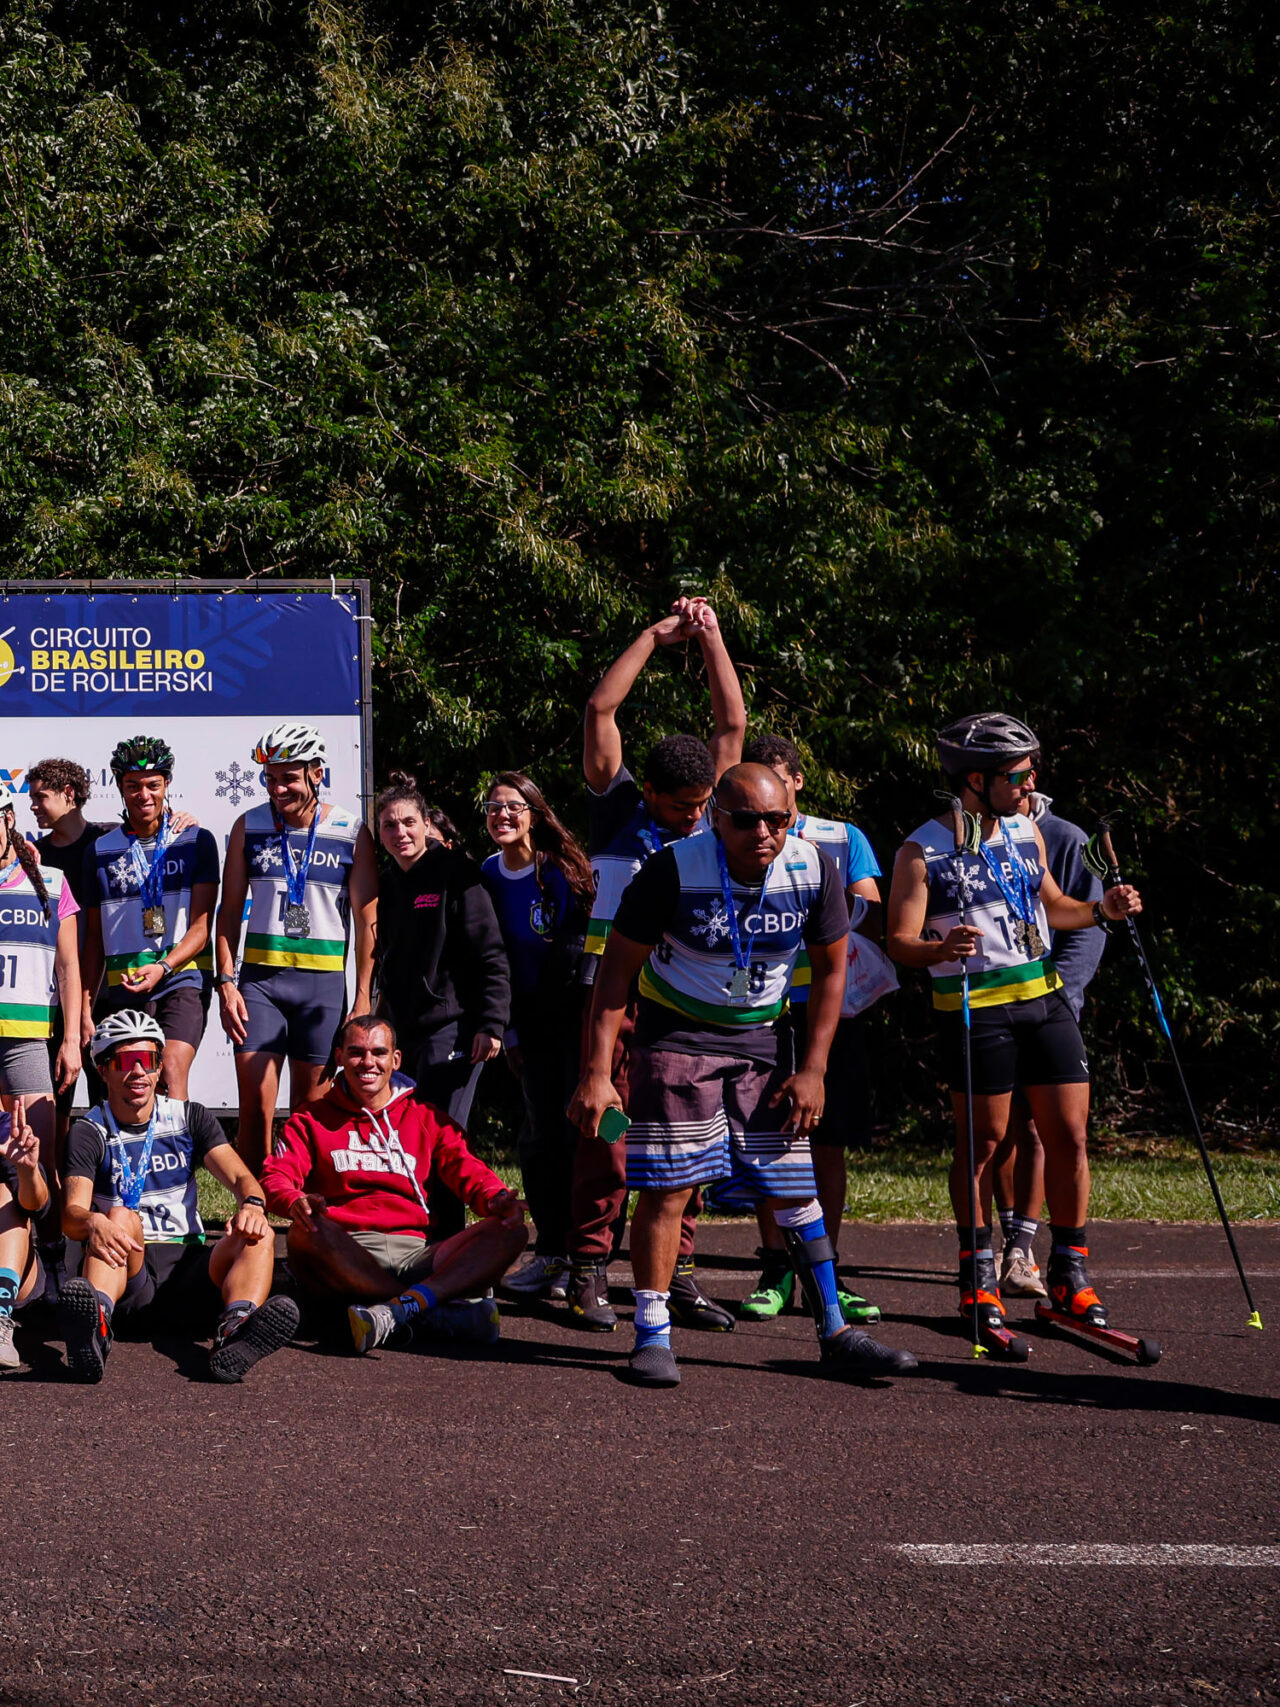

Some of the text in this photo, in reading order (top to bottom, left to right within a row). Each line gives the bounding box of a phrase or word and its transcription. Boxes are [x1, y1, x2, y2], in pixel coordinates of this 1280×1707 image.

[30, 627, 151, 648] CIRCUITO
[31, 649, 206, 670] BRASILEIRO
[31, 671, 213, 692] DE ROLLERSKI
[140, 1203, 176, 1233] 12
